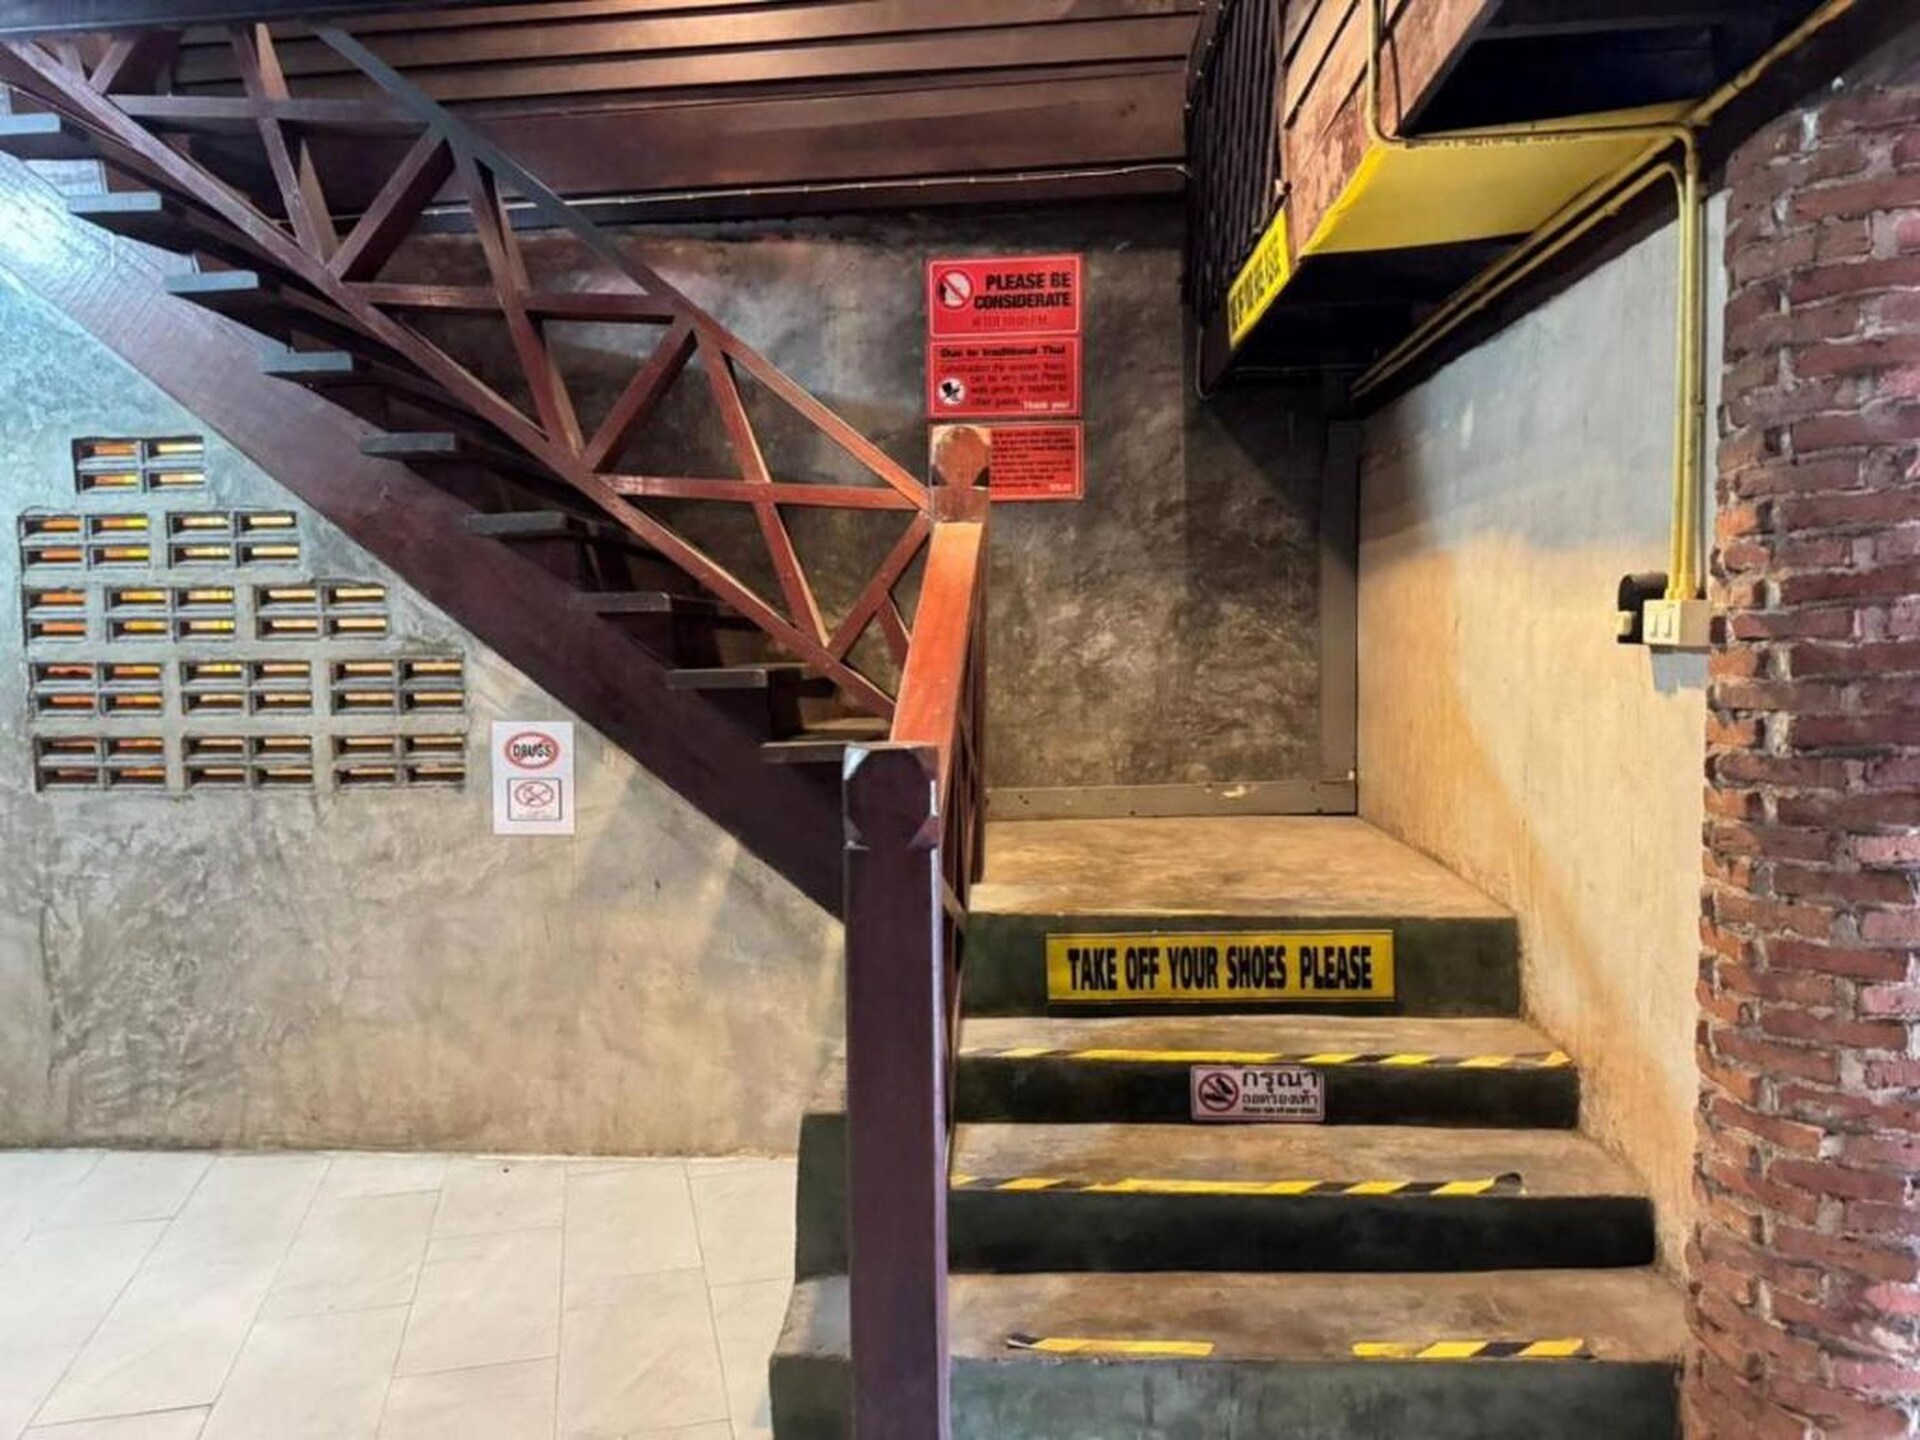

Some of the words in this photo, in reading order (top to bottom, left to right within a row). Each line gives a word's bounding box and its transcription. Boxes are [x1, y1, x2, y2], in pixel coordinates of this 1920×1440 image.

[986, 272, 1045, 290] PLEASE
[1051, 271, 1071, 288] BE
[974, 291, 1071, 310] CONSIDERATE
[941, 348, 962, 358] Due
[967, 347, 979, 356] to
[982, 346, 1037, 356] traditional
[513, 743, 552, 758] DRUGS
[1067, 947, 1117, 991] TAKE
[1125, 946, 1160, 990] OFF
[1167, 946, 1219, 989] YOUR
[1226, 945, 1286, 989] SHOES
[1300, 945, 1373, 990] PLEASE
[1242, 1071, 1318, 1099] กรุณา
